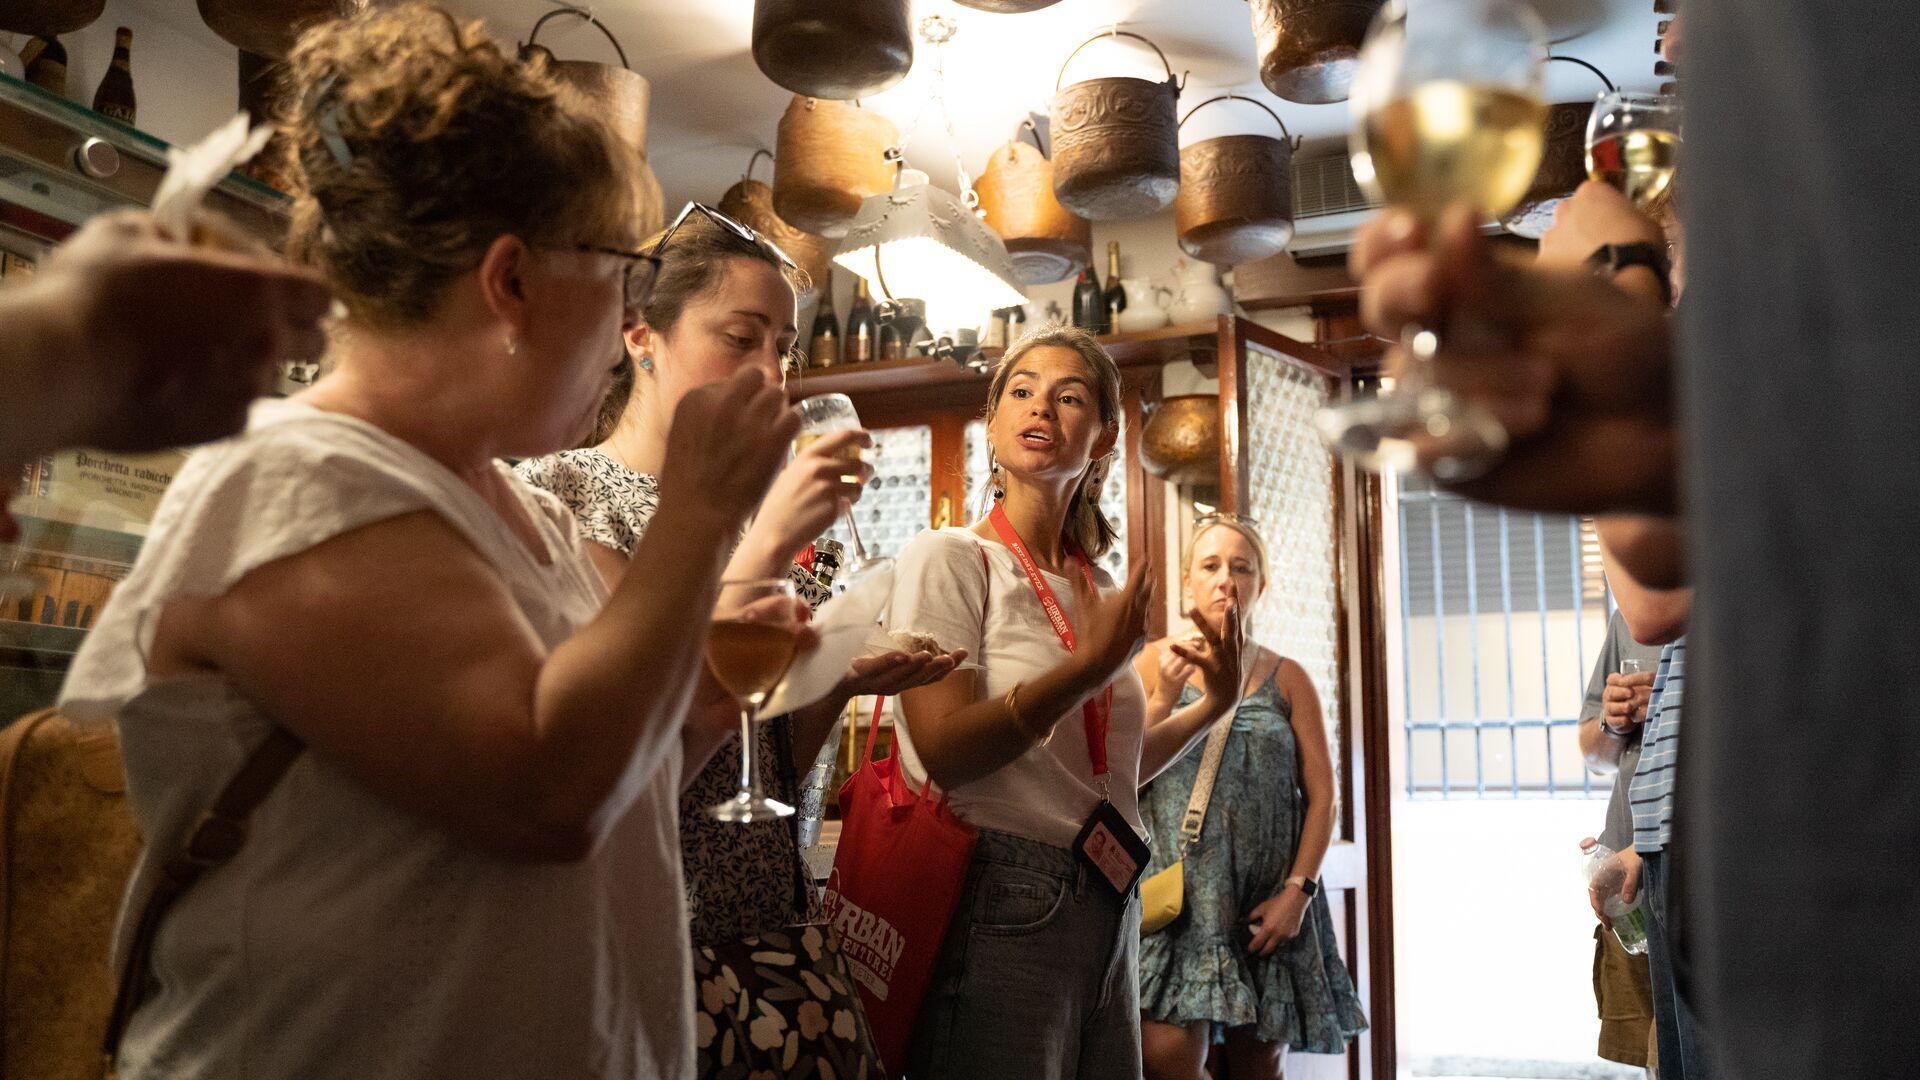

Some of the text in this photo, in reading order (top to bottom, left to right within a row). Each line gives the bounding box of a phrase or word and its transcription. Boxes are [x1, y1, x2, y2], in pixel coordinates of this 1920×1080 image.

[76, 453, 129, 475] Porchetta
[1050, 604, 1068, 634] URBAN
[835, 896, 905, 967] RBAN
[841, 937, 893, 981] ENTURES
